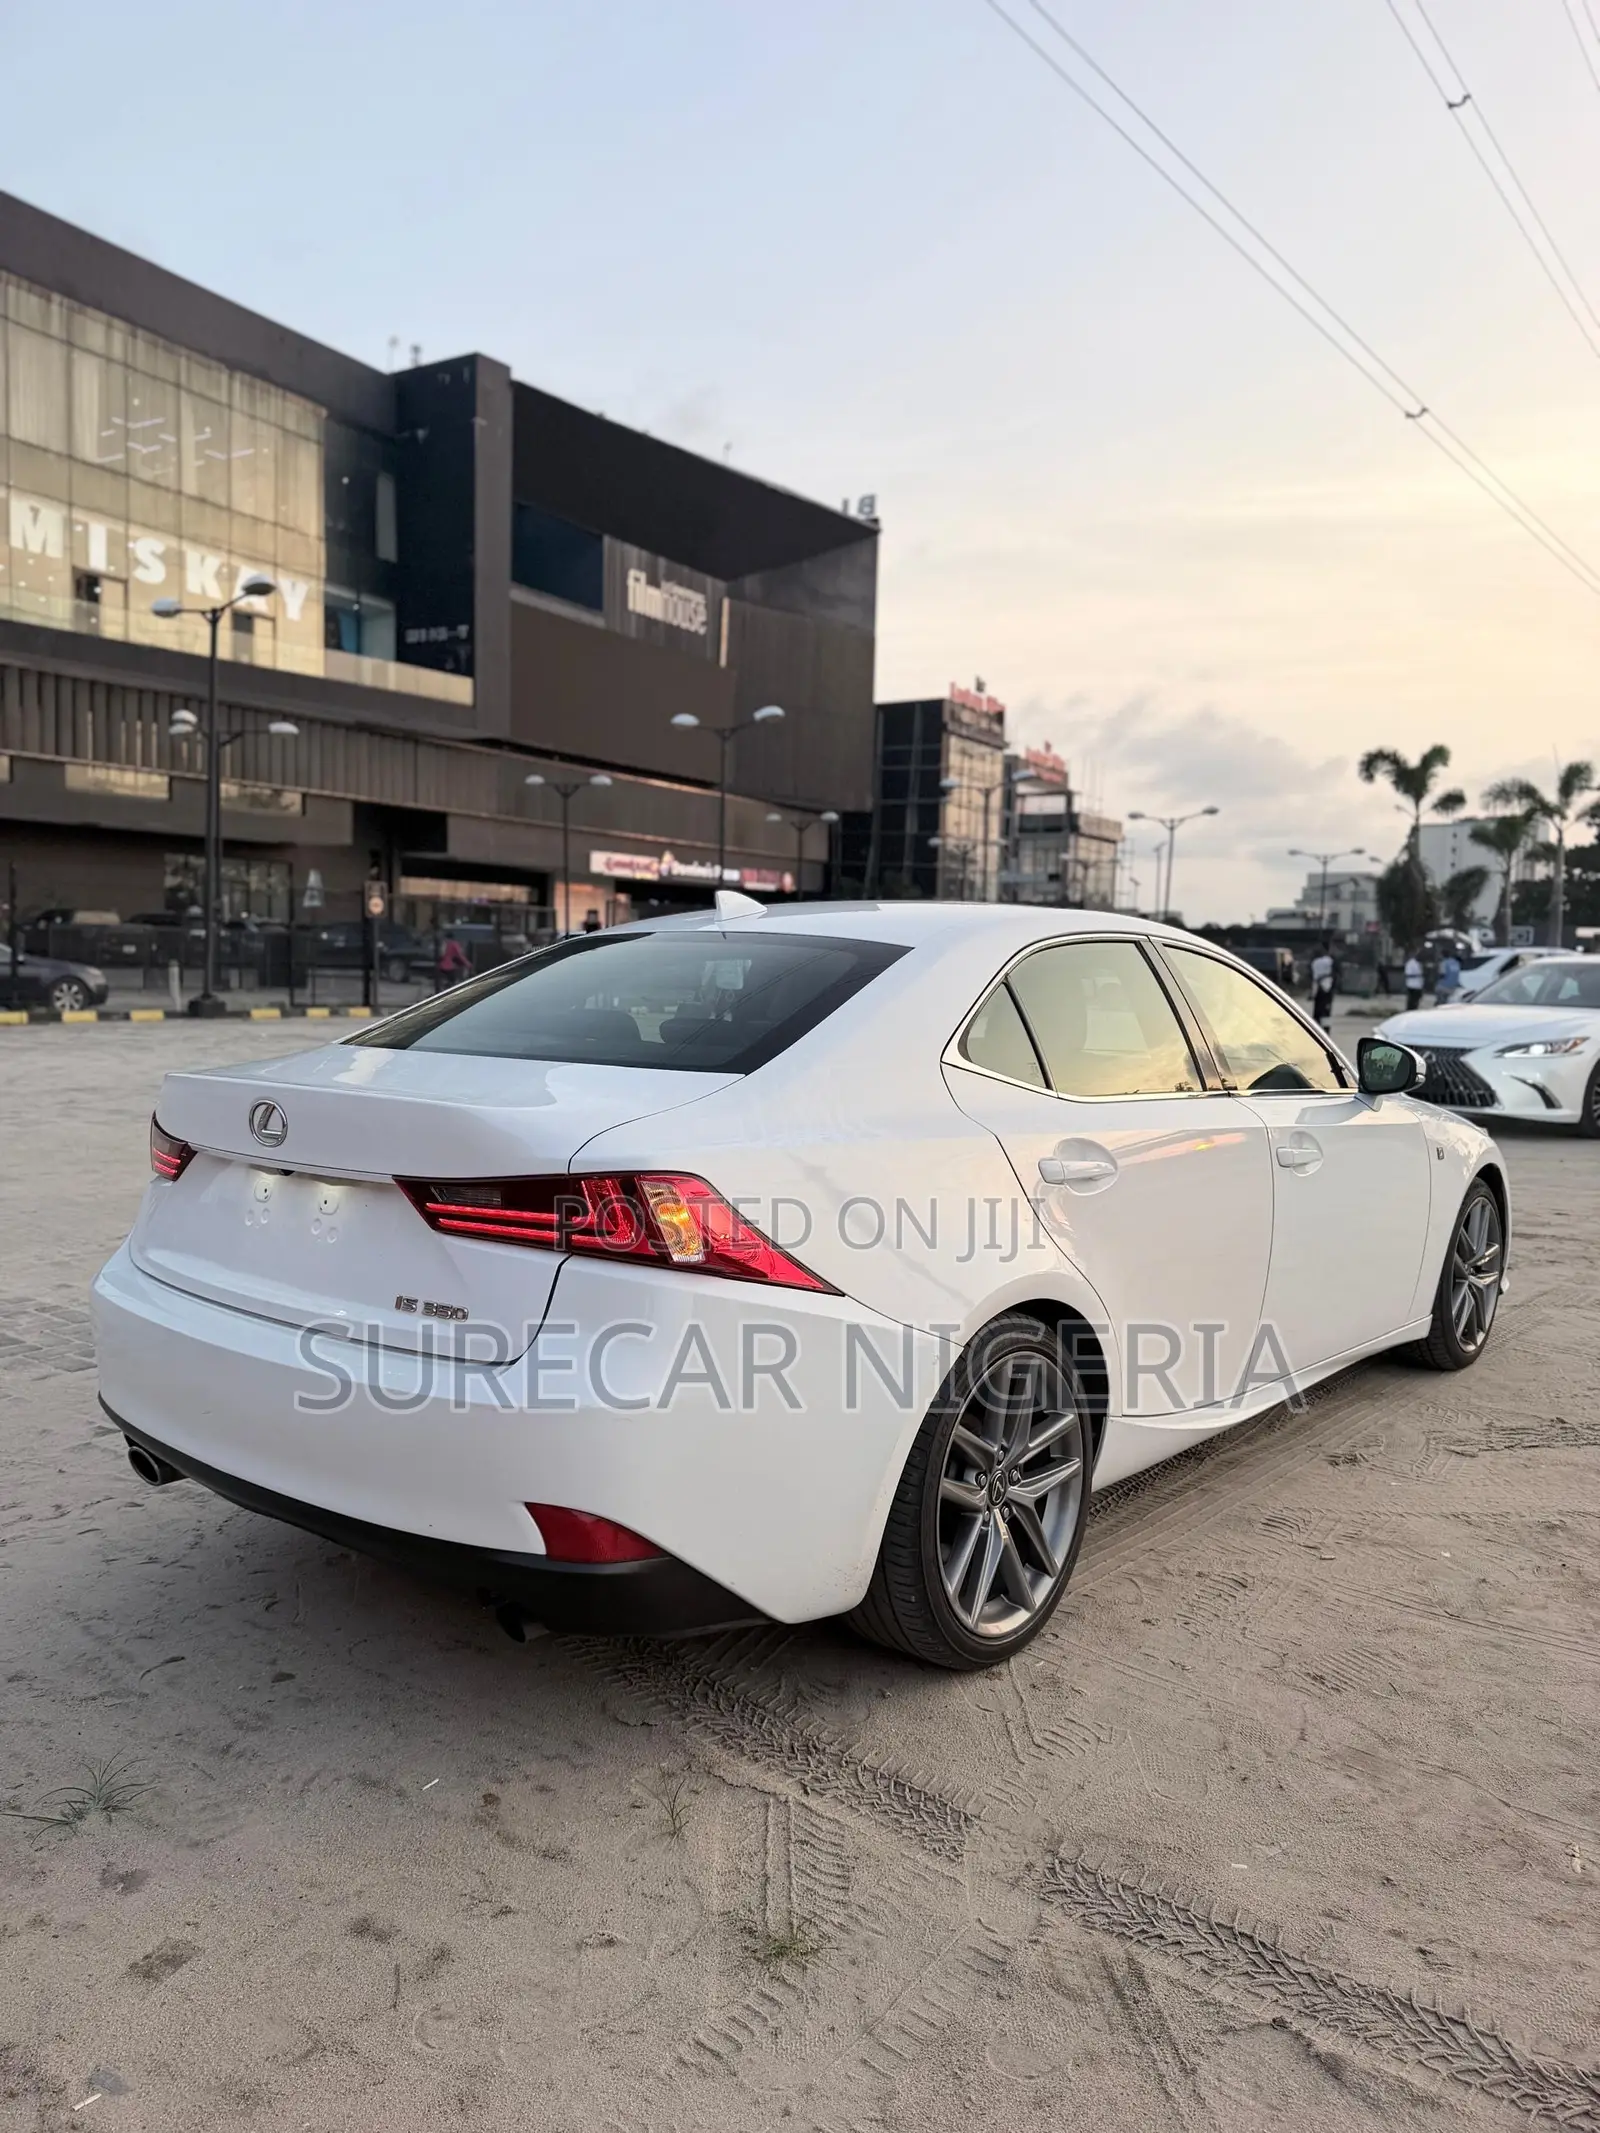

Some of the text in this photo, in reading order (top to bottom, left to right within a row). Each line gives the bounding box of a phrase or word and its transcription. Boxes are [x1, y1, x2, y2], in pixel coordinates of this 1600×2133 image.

[9, 493, 309, 622] MISKAY
[394, 1294, 469, 1322] IS 350
